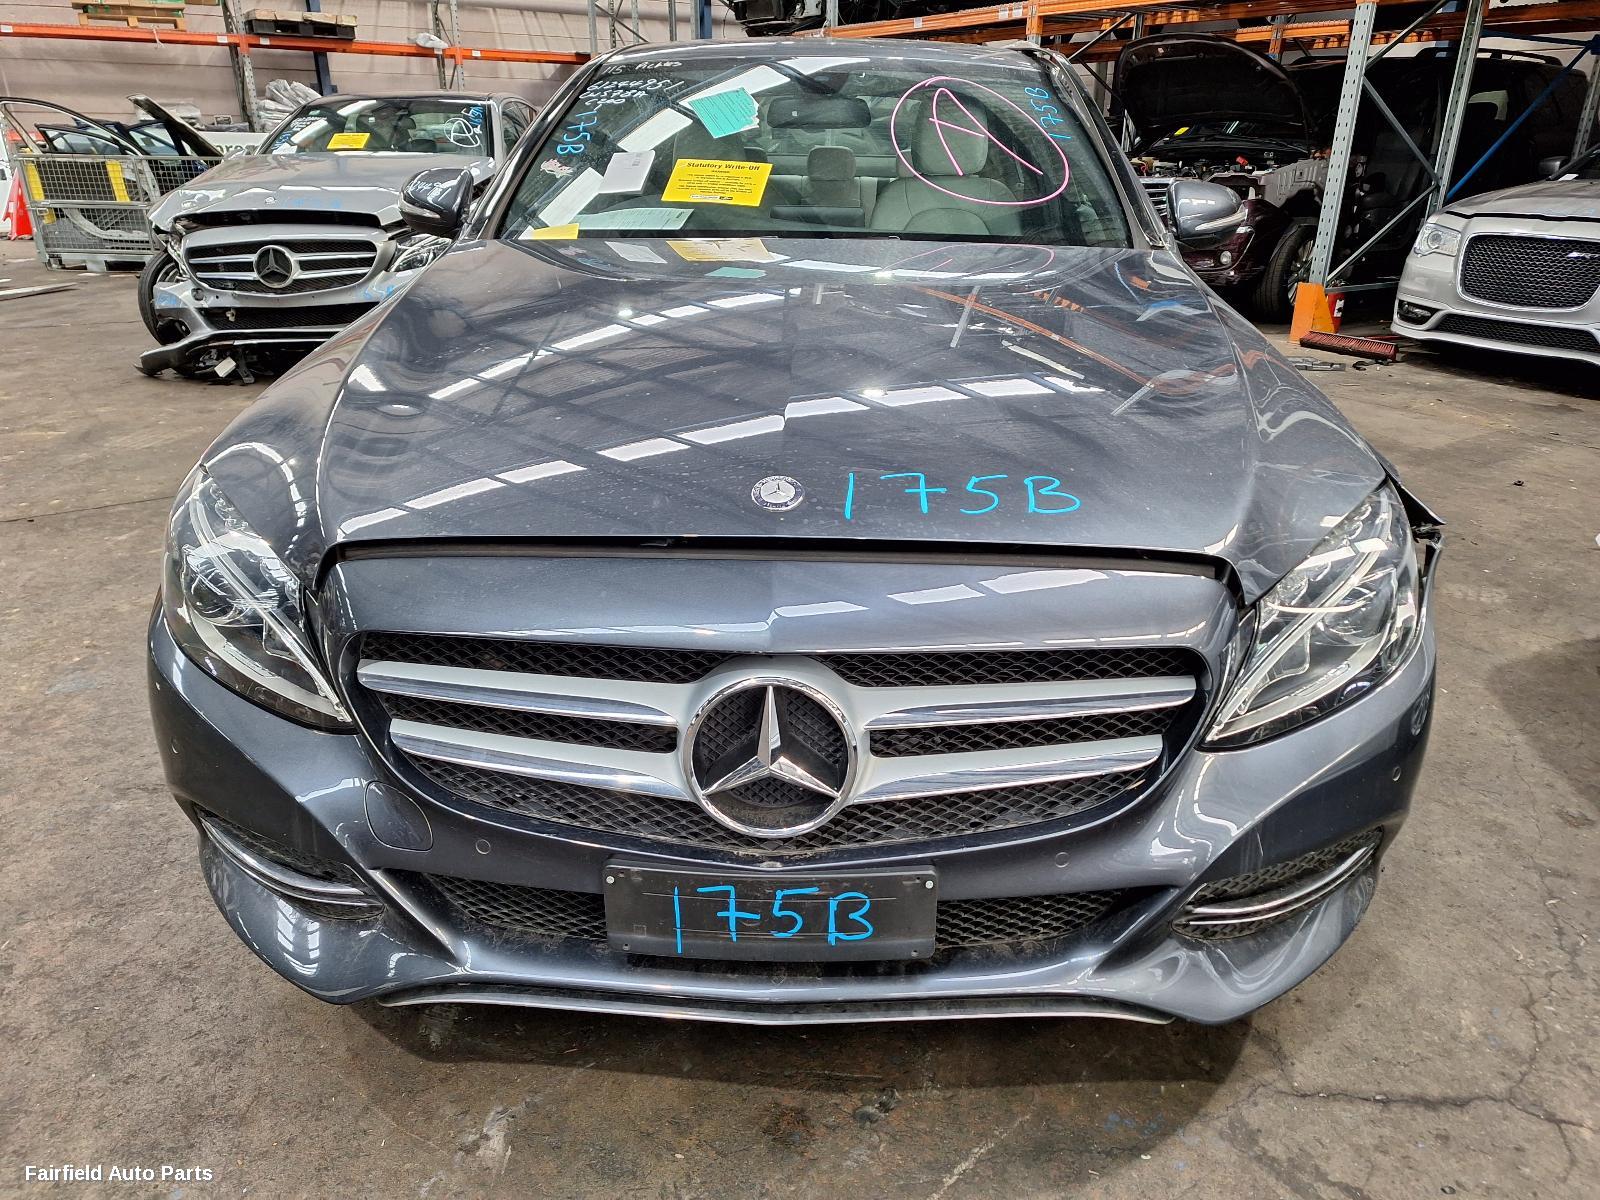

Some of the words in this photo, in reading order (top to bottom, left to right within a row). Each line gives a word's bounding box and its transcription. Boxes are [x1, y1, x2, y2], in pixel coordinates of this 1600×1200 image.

[556, 110, 598, 155] 175B
[1024, 87, 1072, 139] 175B
[686, 162, 723, 170] Statutory
[724, 163, 760, 171] Write-Off
[844, 472, 1081, 519] 175B
[673, 885, 874, 954] 175B
